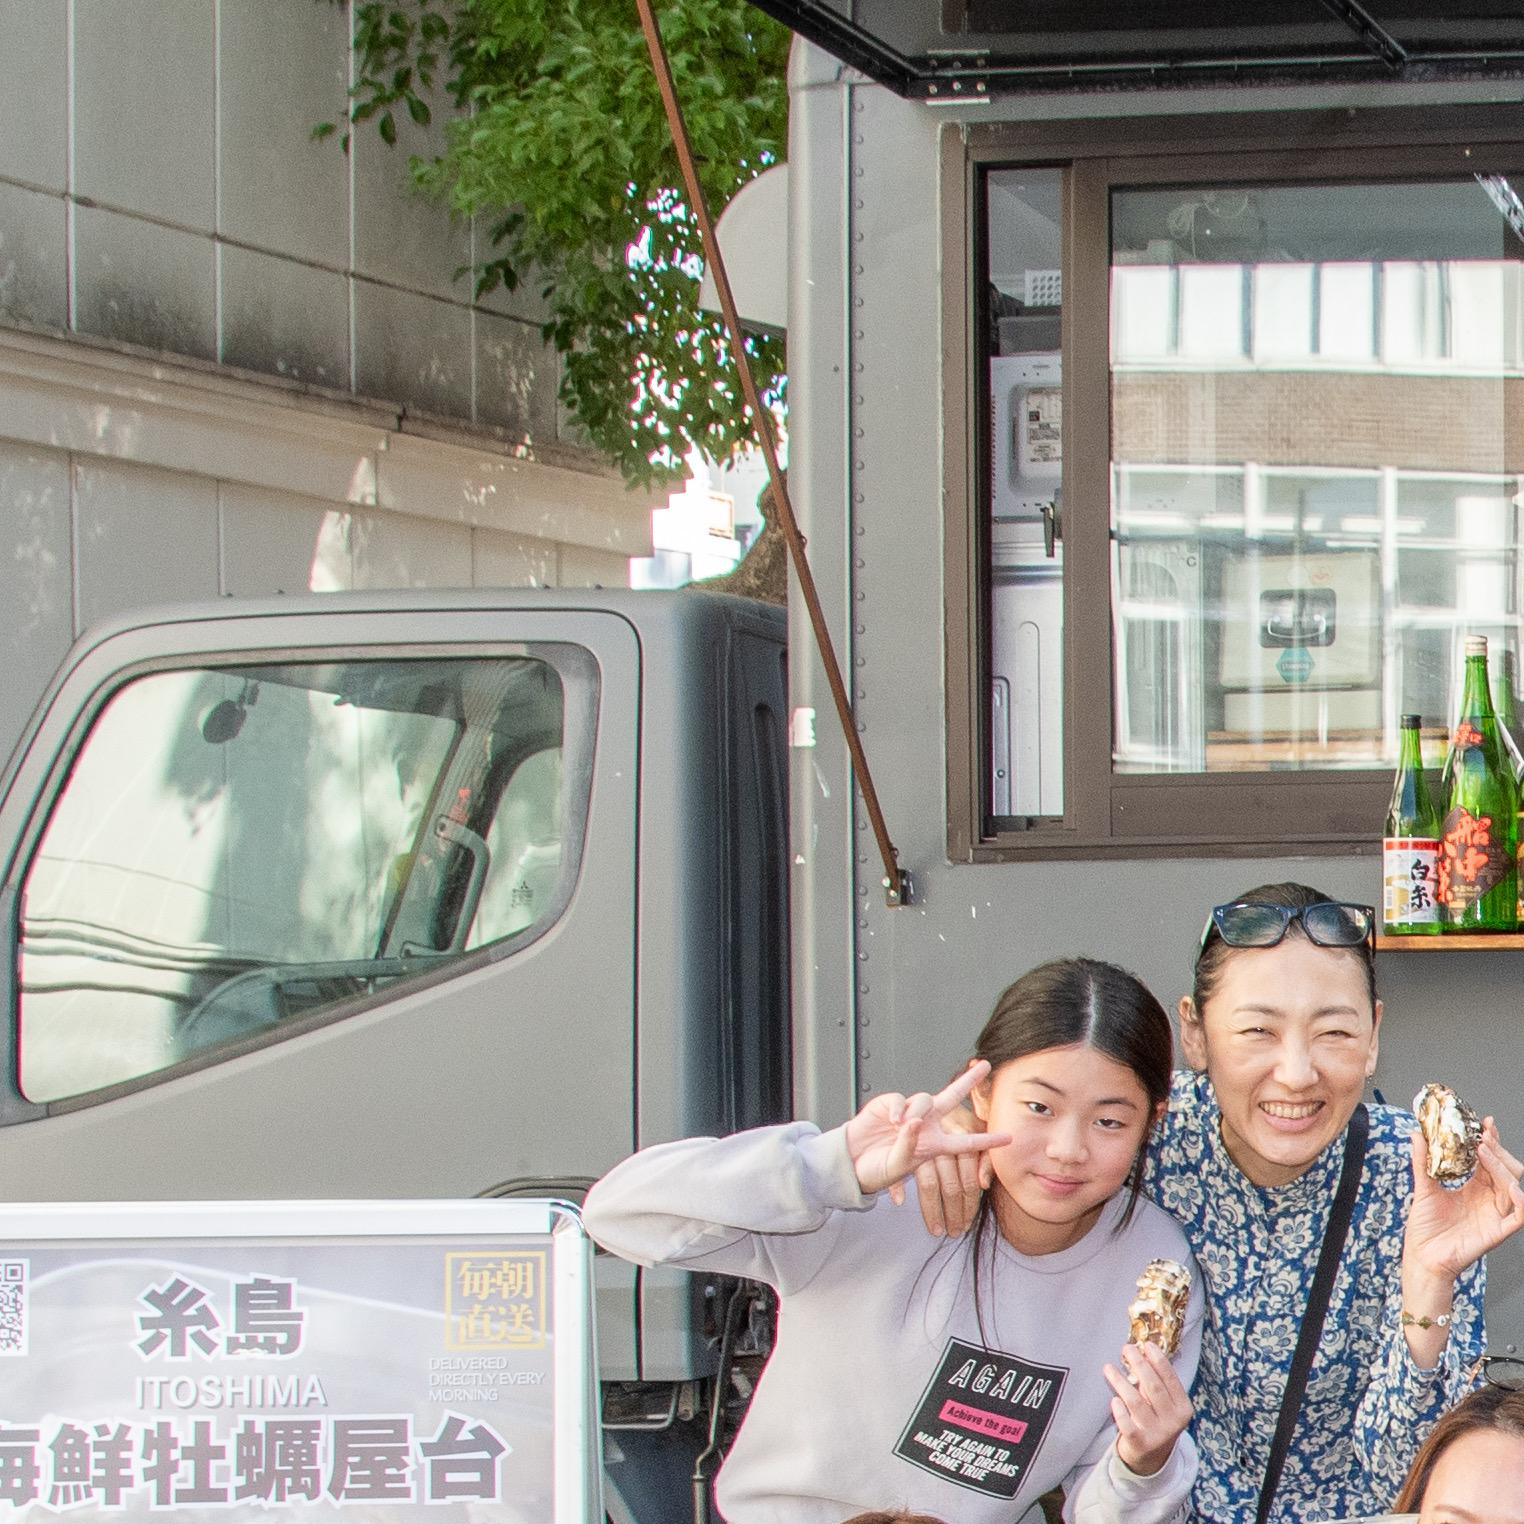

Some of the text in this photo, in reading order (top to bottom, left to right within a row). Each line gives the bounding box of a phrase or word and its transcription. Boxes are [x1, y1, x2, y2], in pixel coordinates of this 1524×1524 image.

[136, 1274, 306, 1359] 糸島
[430, 1357, 508, 1371] DELIVERED
[430, 1372, 545, 1387] DIRECTLY EVERY
[135, 1374, 327, 1408] ITOSHIMA
[429, 1388, 500, 1402] MORNING
[948, 1359, 1052, 1409] AGAIN
[946, 1406, 1022, 1437] Achieve the goal
[913, 1431, 1020, 1477] MAKE YOUR DREAMS
[939, 1429, 1010, 1462] TRY AGAIN TO
[928, 1450, 990, 1481] COME TRUE
